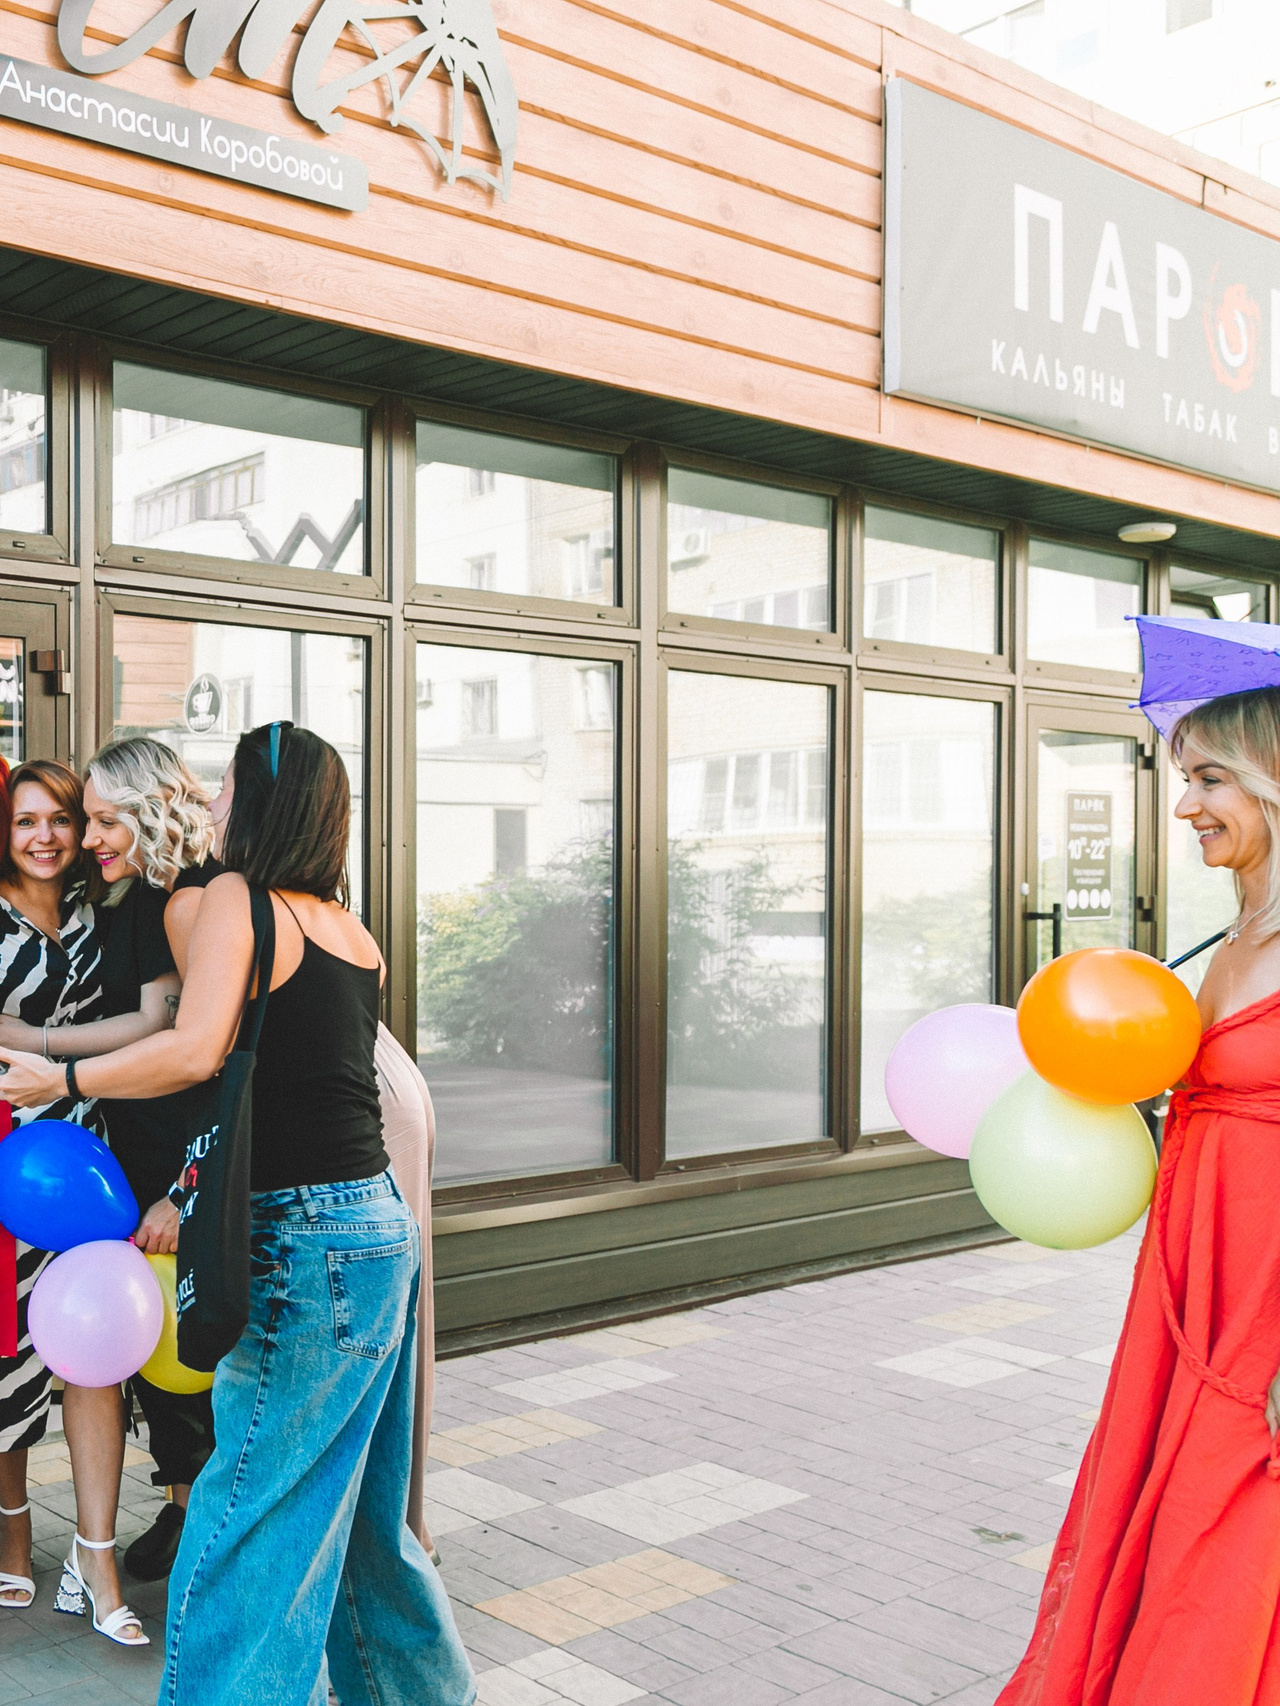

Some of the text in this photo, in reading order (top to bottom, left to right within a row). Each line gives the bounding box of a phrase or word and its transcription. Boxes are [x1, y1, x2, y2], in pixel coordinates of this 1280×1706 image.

[200, 117, 344, 192] Коробовой
[1014, 183, 1280, 398] ПАРО
[991, 338, 1125, 409] КАЛЬЯНЫ
[1162, 392, 1238, 443] ТАБАК
